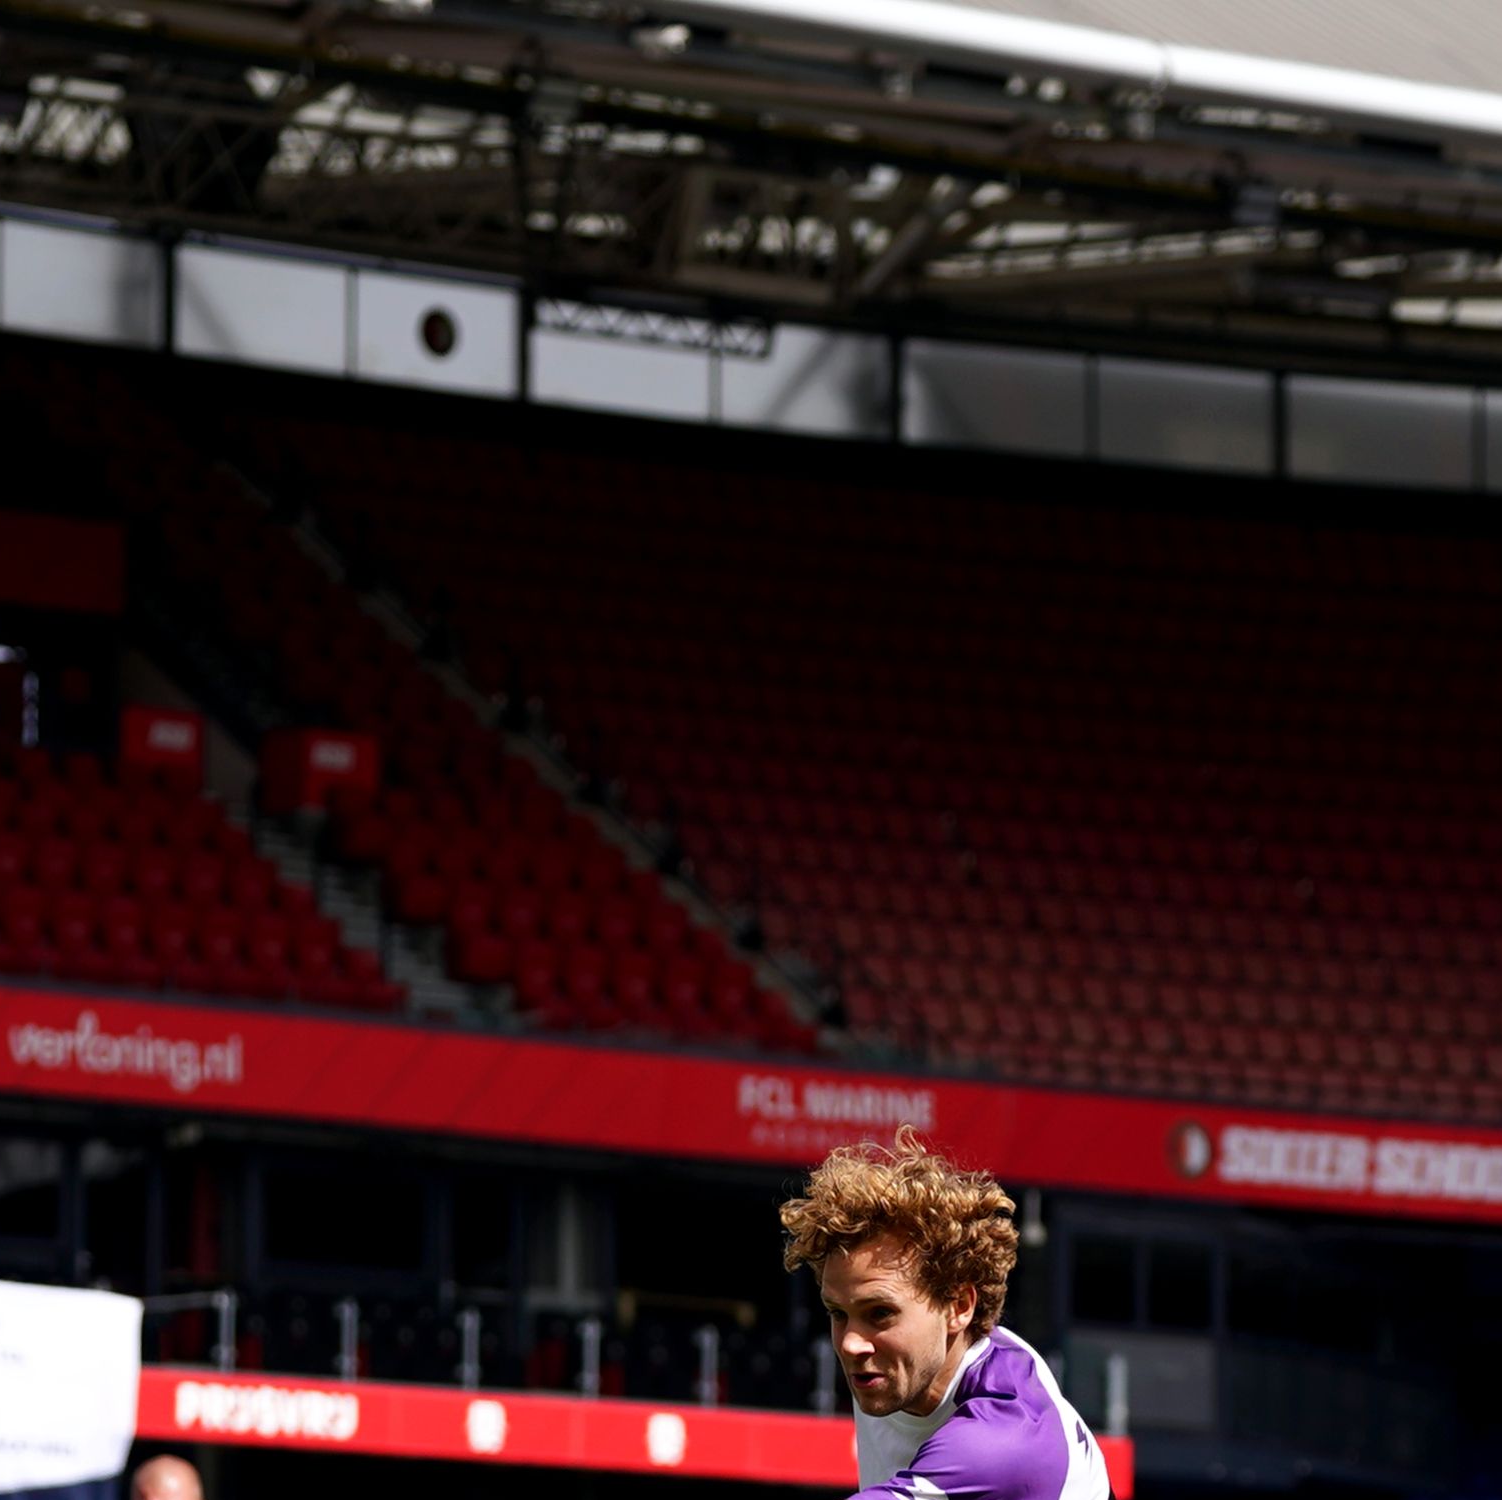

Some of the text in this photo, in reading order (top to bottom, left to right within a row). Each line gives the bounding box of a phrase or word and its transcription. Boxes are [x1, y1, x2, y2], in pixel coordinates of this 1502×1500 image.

[738, 1074, 936, 1133] FCL MARINE
[1218, 1124, 1368, 1192] SOCCER
